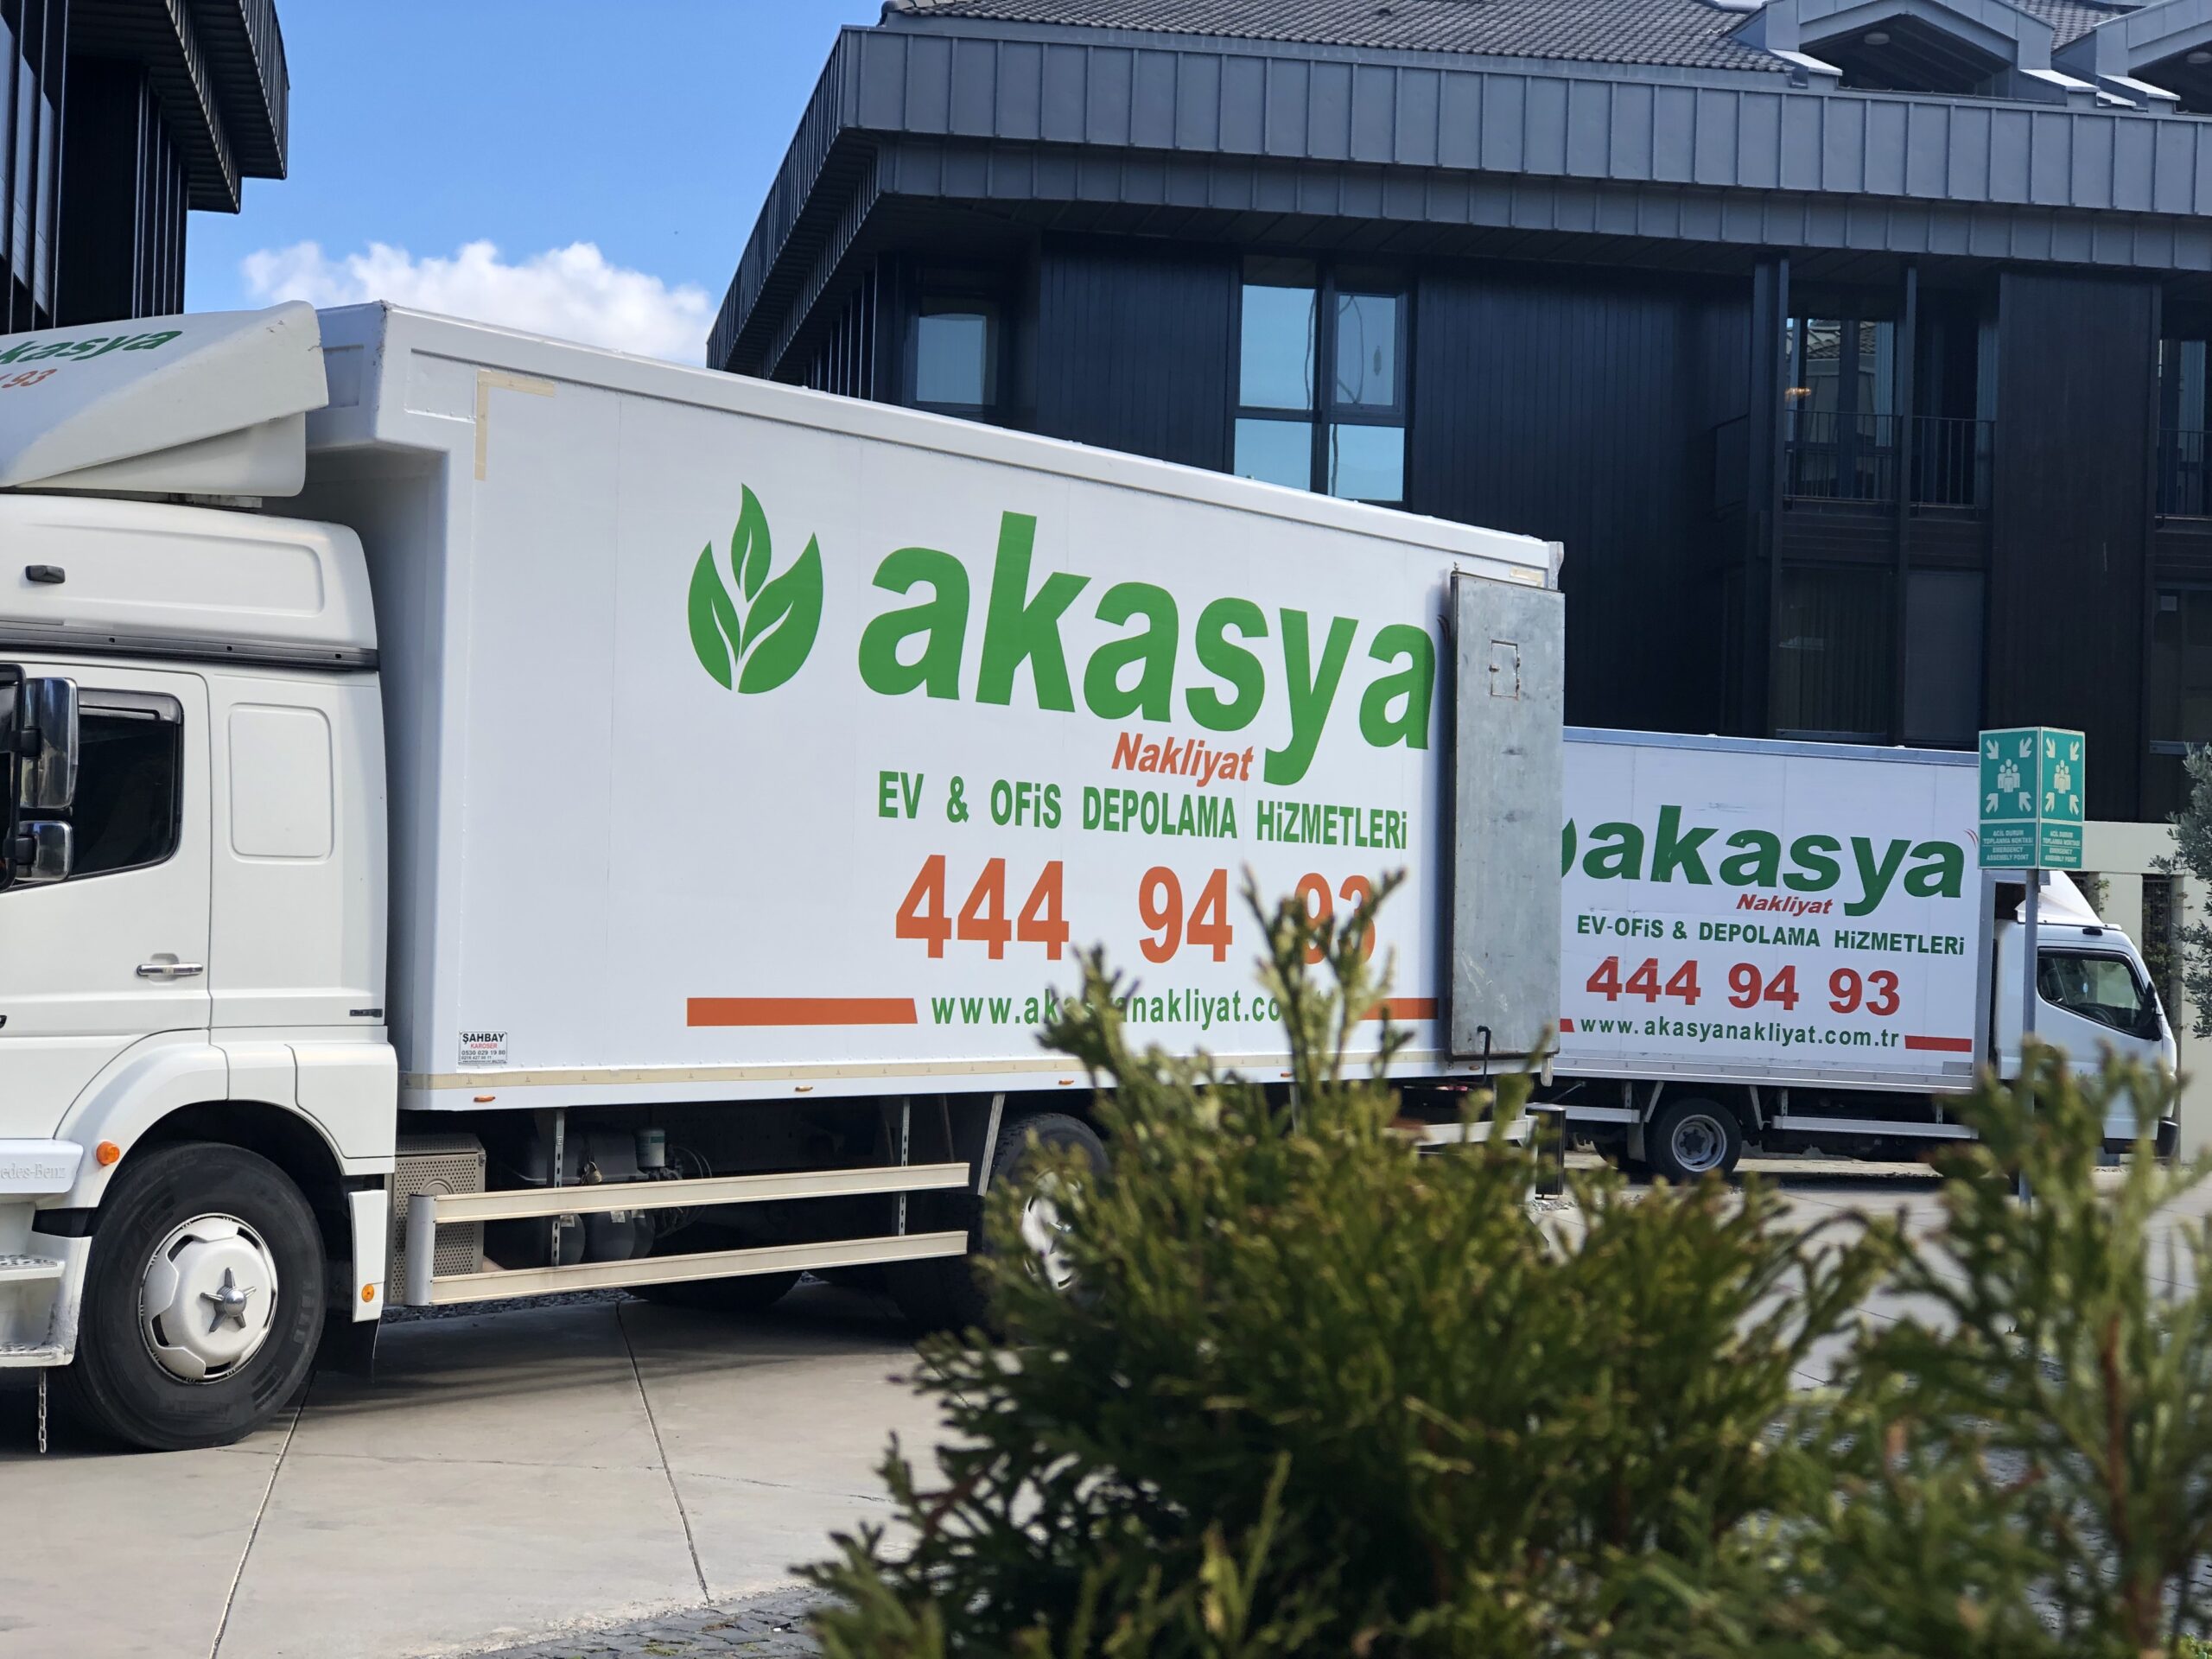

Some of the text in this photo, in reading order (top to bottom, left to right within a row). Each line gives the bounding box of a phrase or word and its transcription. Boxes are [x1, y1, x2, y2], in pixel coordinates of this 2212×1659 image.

[0, 331, 183, 365] kasya
[2, 368, 58, 389] 93
[857, 511, 1436, 785] akasya
[1111, 732, 1254, 787] Nakliyat
[878, 770, 924, 819] EV
[947, 774, 969, 823] &
[1082, 785, 1238, 839] DEPOLAMA
[1581, 804, 1965, 917] akasya
[895, 854, 1376, 965] 444 94 93
[1736, 893, 1833, 918] Nakliyat
[1673, 920, 1688, 940] &
[1699, 922, 1821, 947] DEPOLAMA
[1586, 957, 1900, 1016] 444 94 93
[462, 1033, 505, 1045] ŞAHBAY
[1580, 1016, 1899, 1048] www.akasyanakliyat.com.tr
[0, 1163, 67, 1179] edes-Benz
